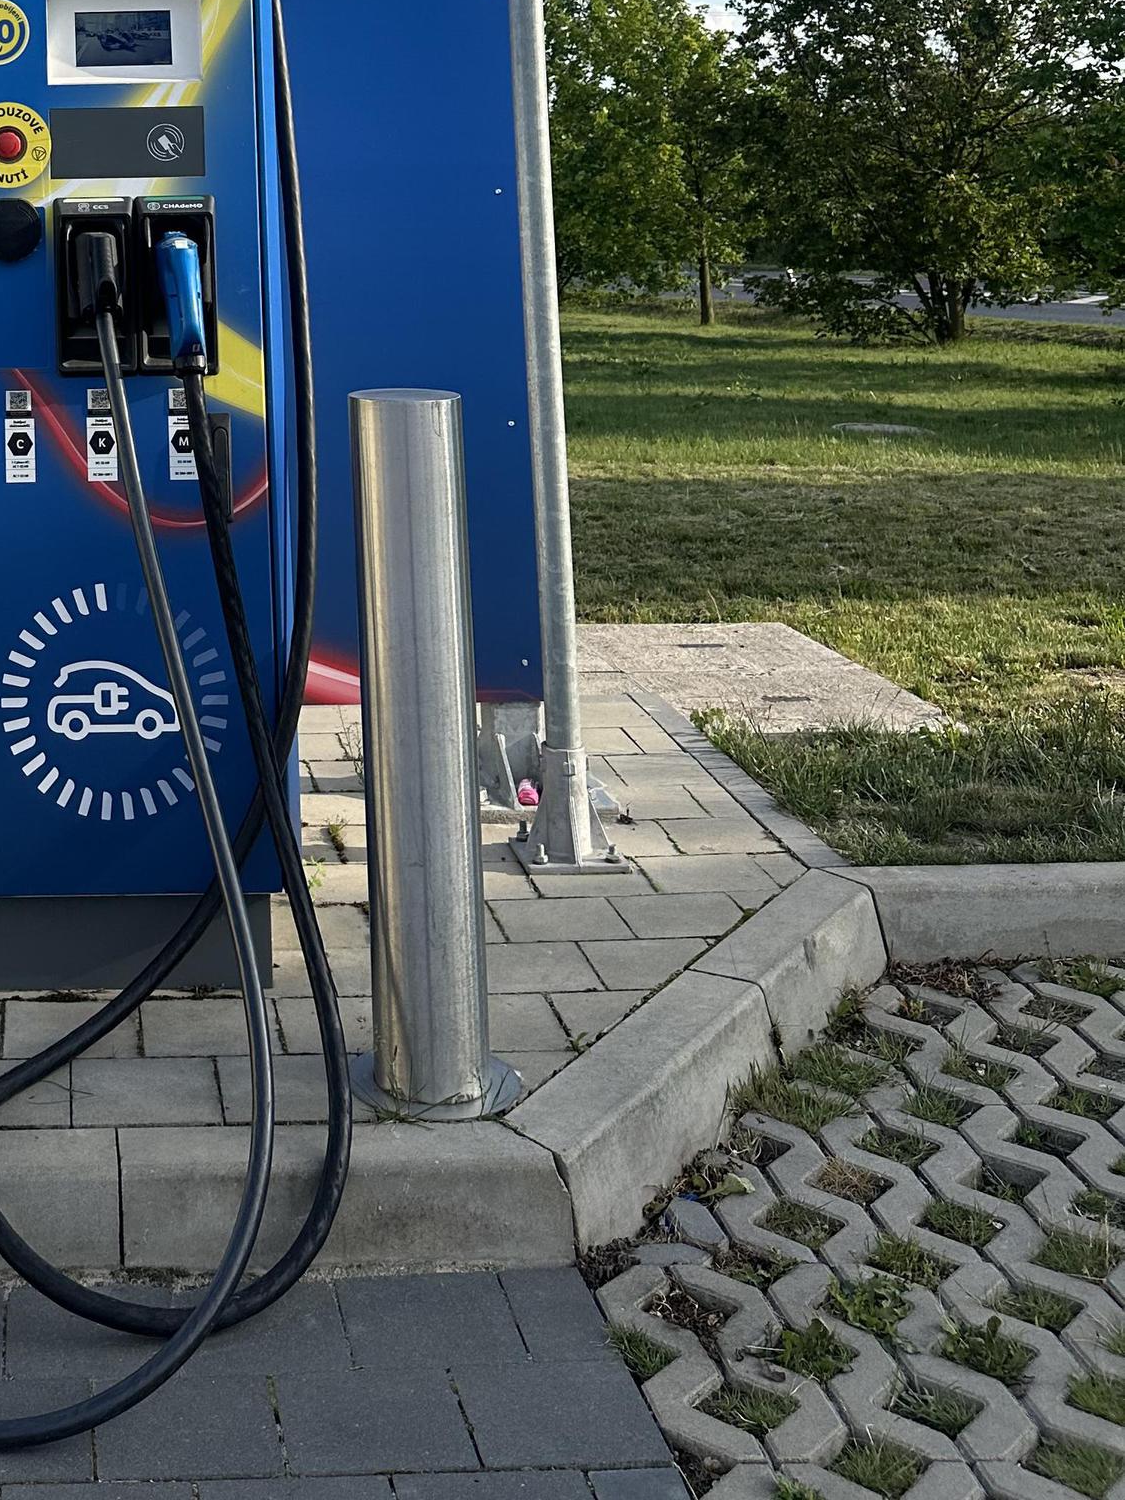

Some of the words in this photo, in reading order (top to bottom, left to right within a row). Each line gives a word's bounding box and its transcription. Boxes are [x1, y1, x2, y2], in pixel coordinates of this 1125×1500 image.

[92, 203, 110, 211] CCS
[15, 438, 26, 450] C
[97, 437, 107, 449] K
[178, 435, 190, 447] M
